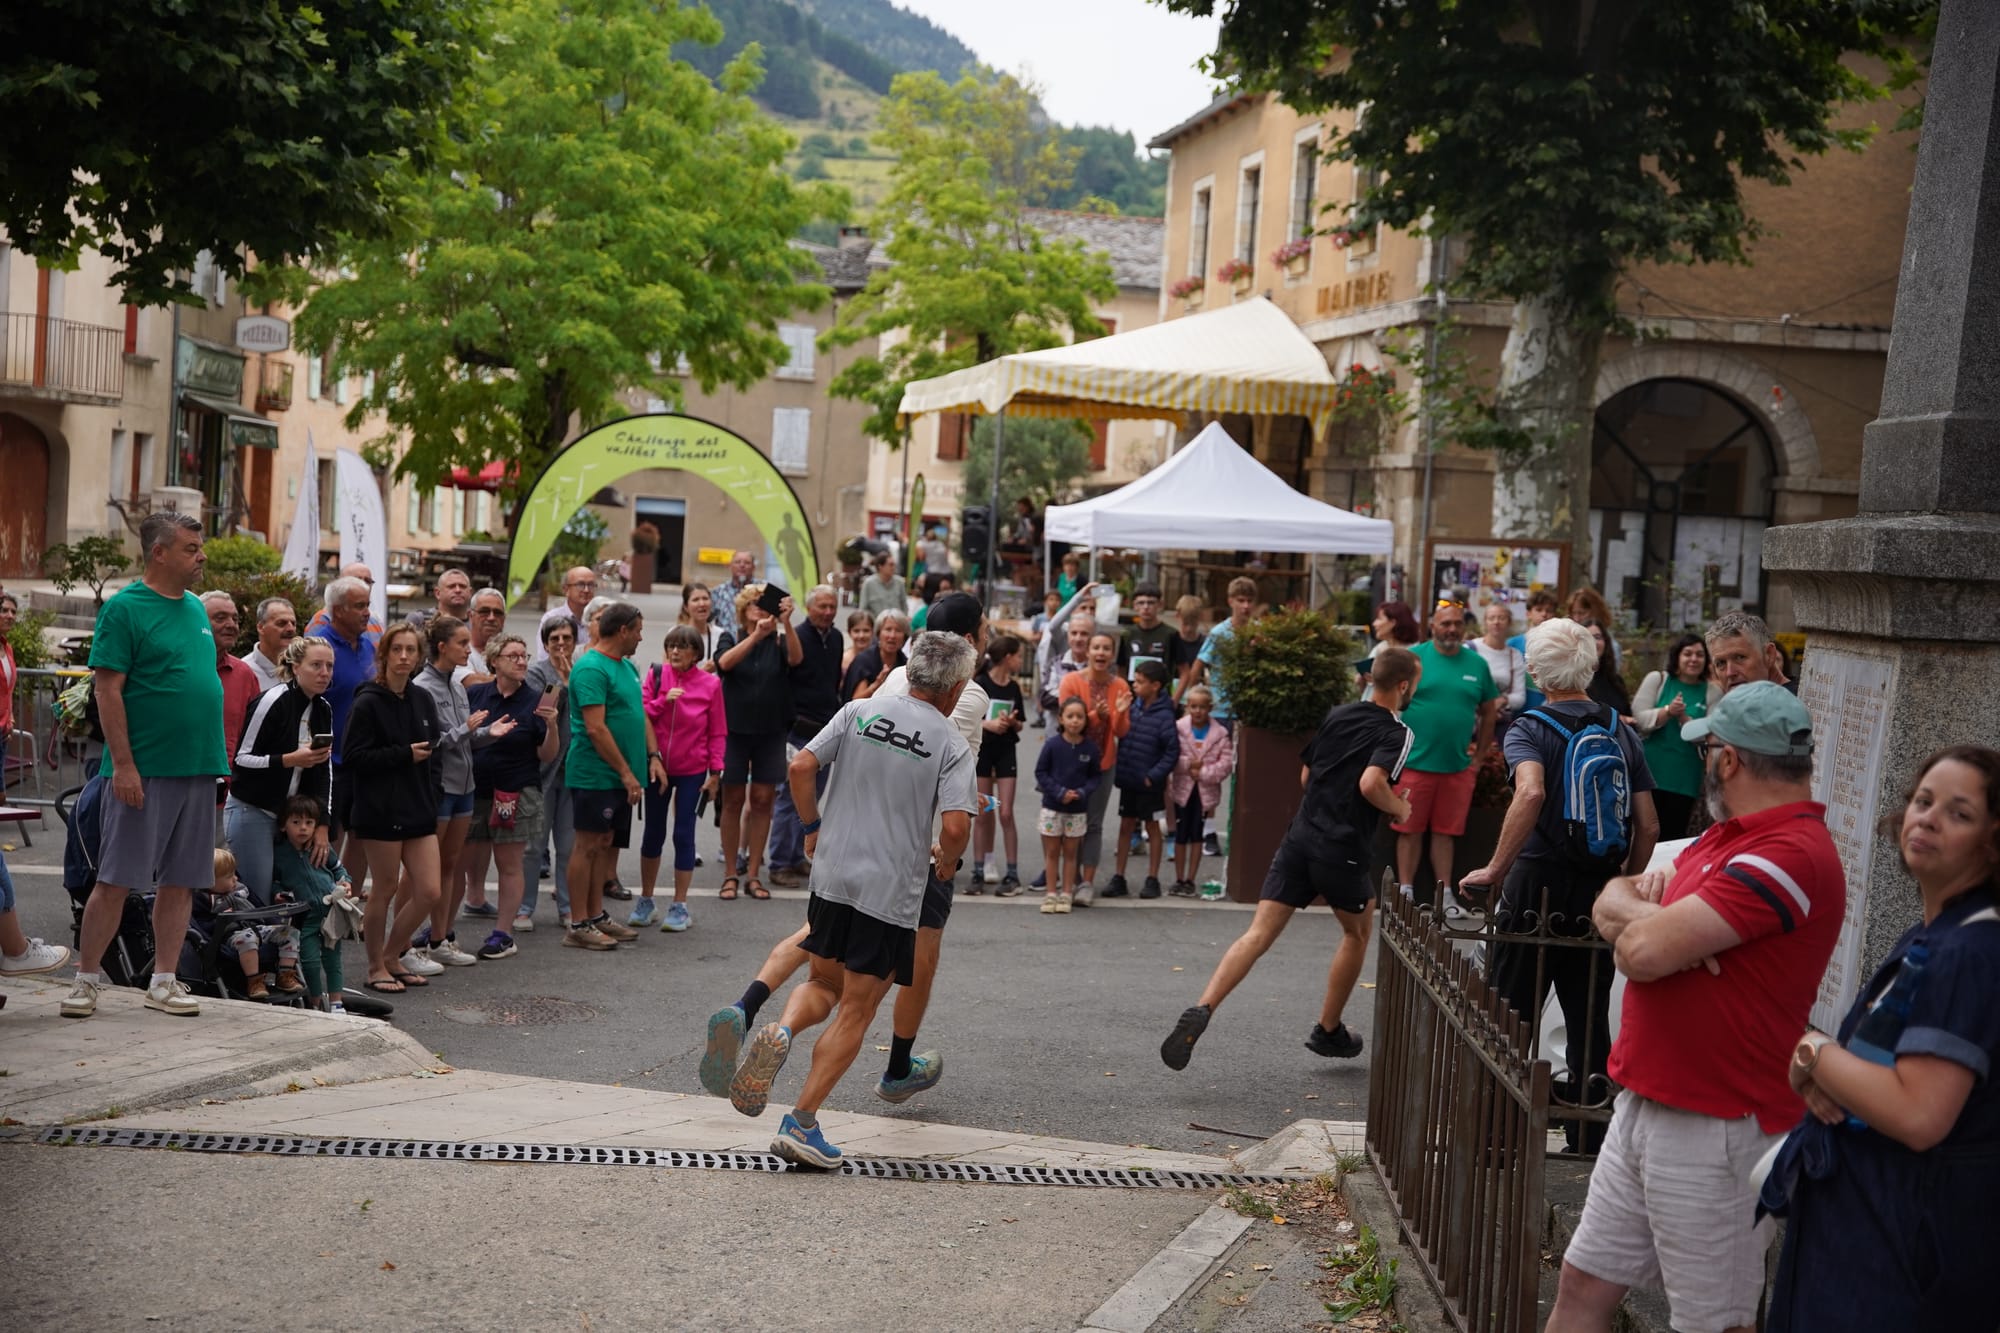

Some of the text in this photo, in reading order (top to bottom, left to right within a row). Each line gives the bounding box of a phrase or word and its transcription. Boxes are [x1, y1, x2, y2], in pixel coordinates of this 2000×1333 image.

[1317, 271, 1391, 314] MAIRIE
[242, 324, 283, 345] PIZZERIA
[615, 431, 720, 449] Challenge des
